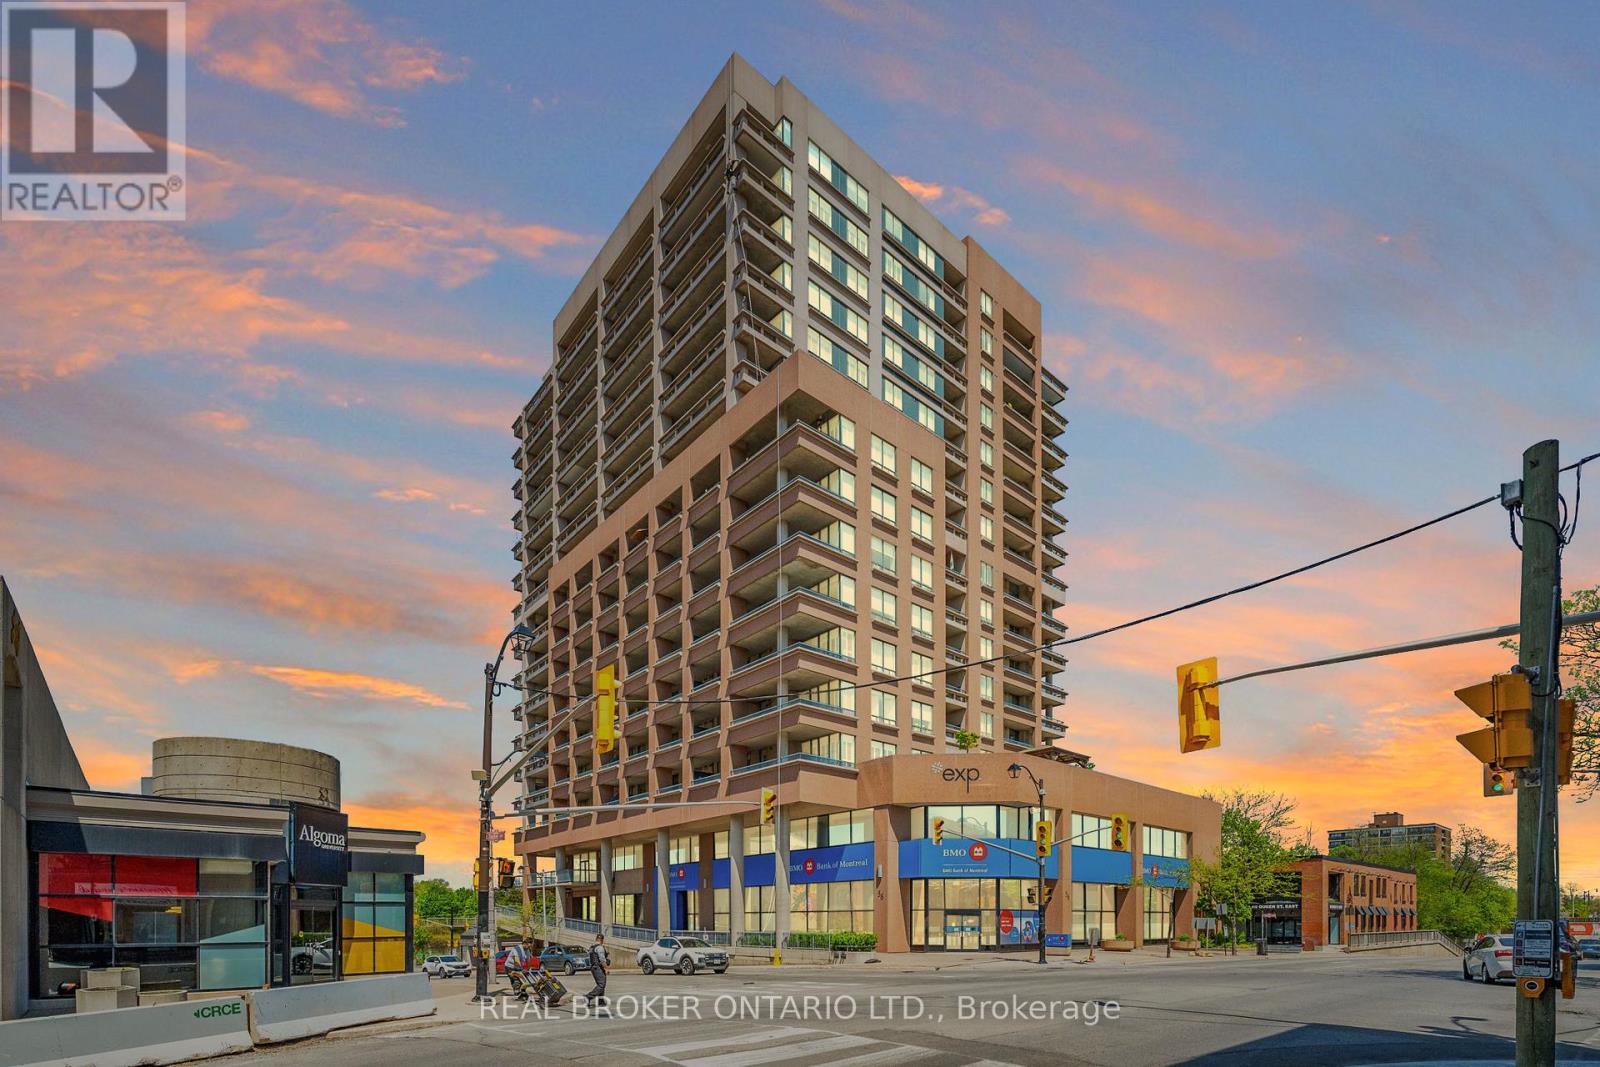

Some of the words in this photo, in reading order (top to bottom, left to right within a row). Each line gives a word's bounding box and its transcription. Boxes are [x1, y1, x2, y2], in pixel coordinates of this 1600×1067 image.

[943, 768, 980, 793] exp
[299, 824, 345, 847] Algoma
[943, 849, 967, 857] BMO
[816, 861, 832, 871] Bank
[832, 860, 839, 869] of
[840, 858, 868, 868] Montreal
[200, 1003, 241, 1018] CRCE
